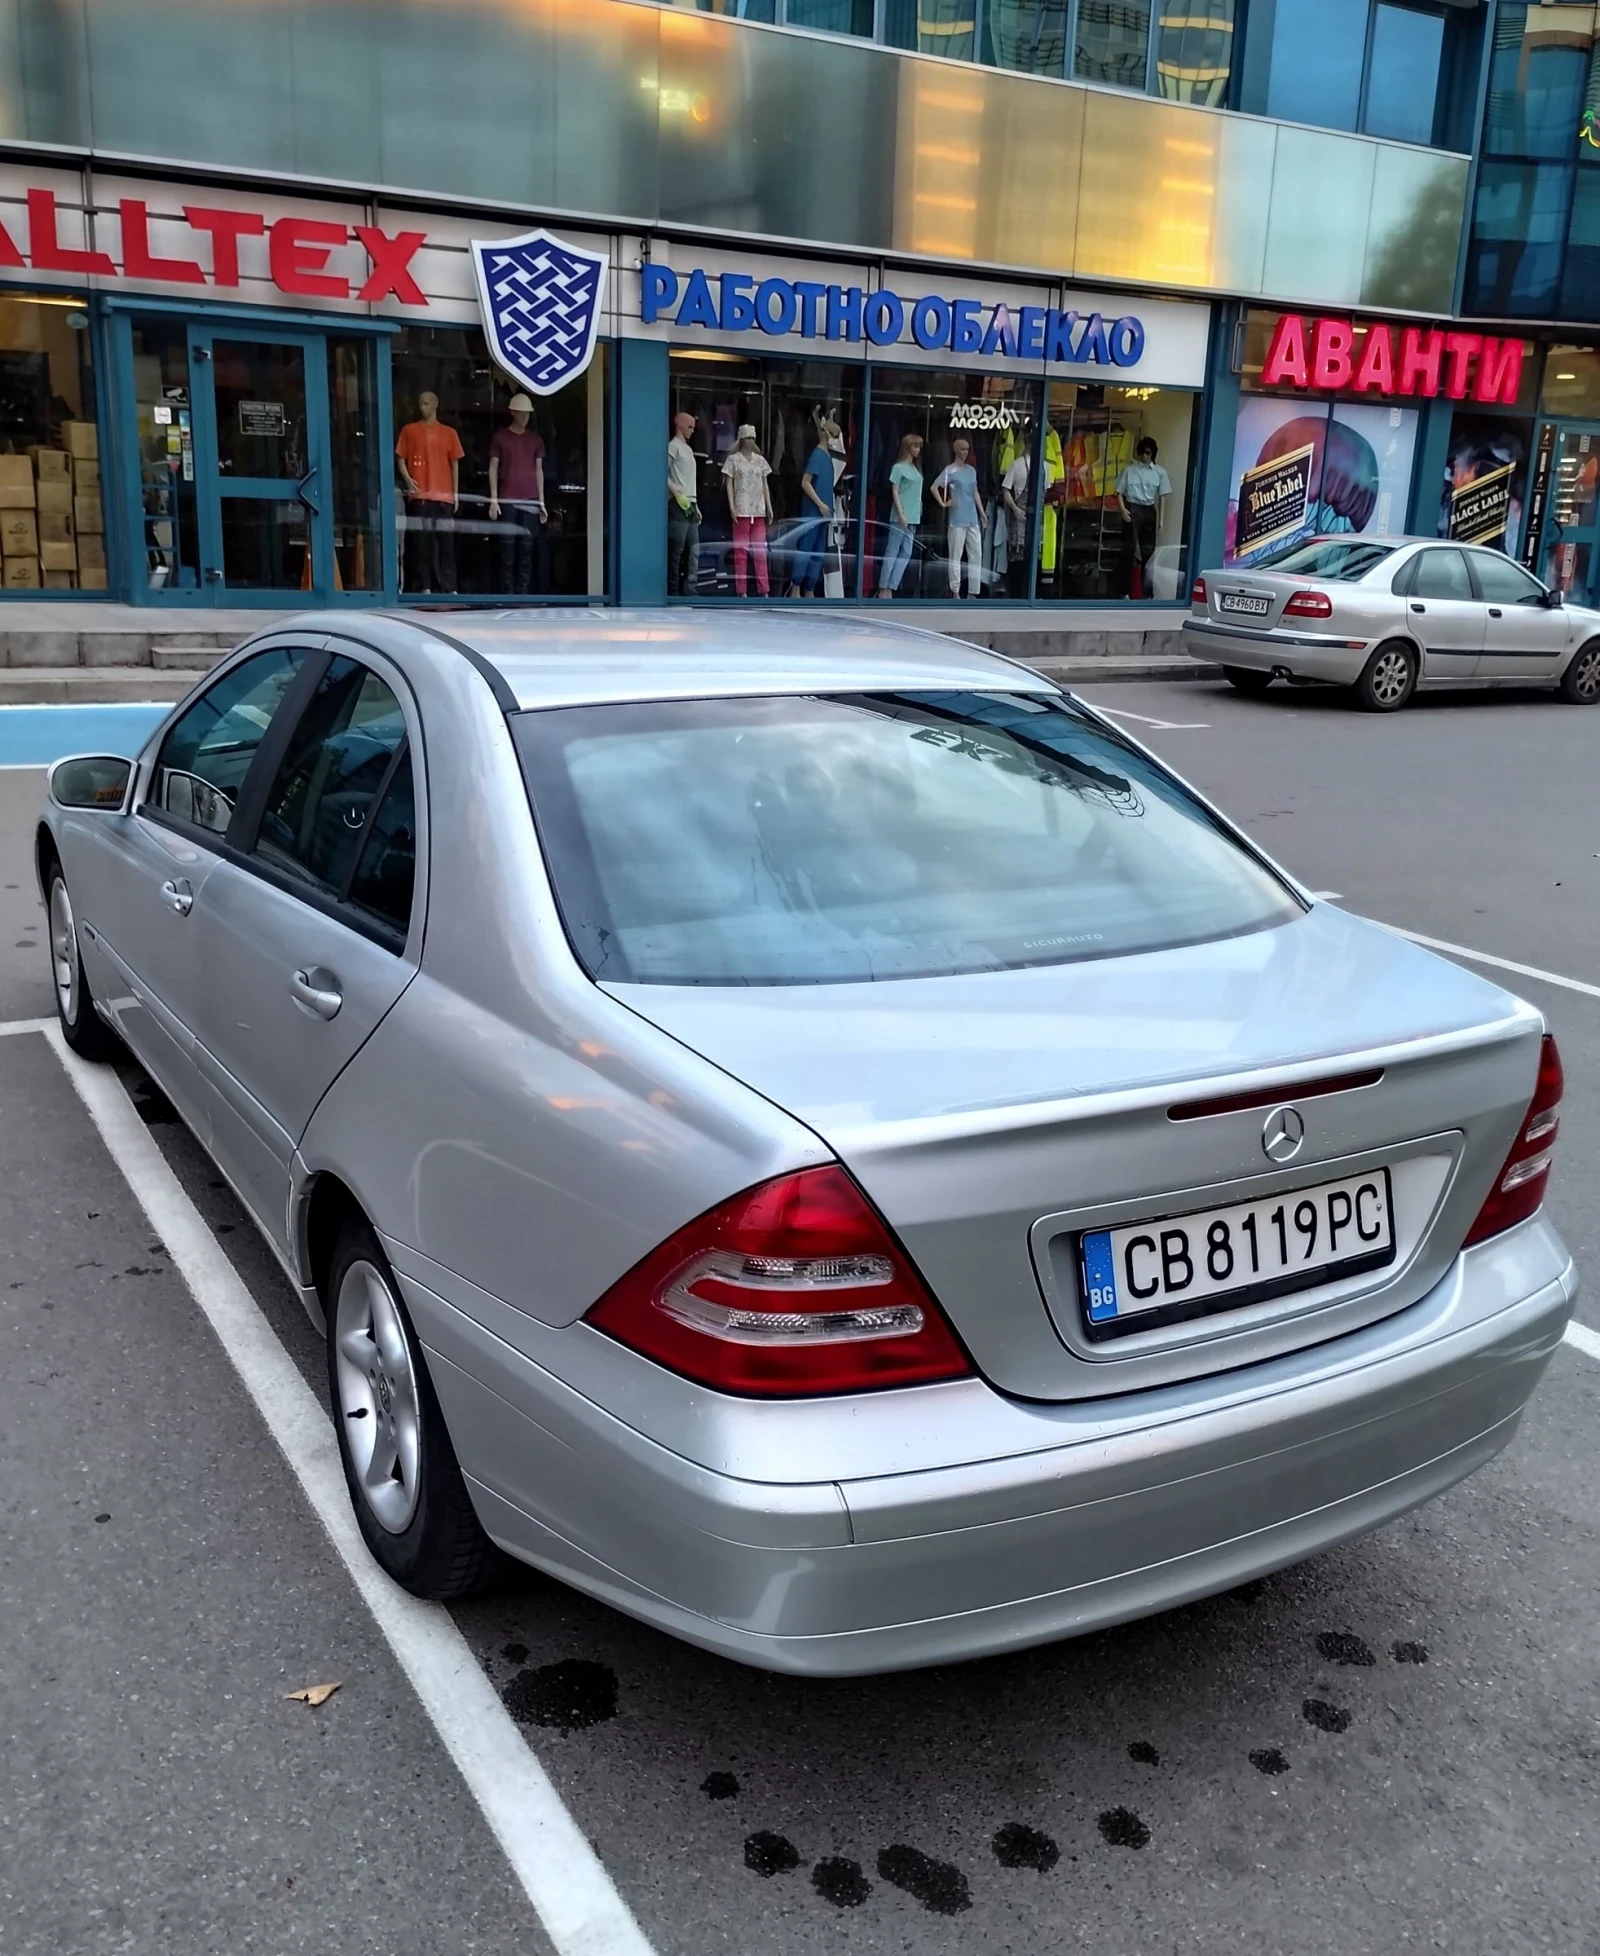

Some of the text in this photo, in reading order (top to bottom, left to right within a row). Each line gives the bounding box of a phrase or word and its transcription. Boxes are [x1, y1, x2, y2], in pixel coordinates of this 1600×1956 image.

[641, 263, 1147, 367] РАБОТНО ОБЛЕКЛО
[1261, 314, 1526, 404] АВАНТИ
[1249, 488, 1276, 513] Blue
[1274, 472, 1304, 501] Label
[1450, 502, 1480, 525] BLACK
[1481, 488, 1510, 510] LABEL
[1023, 933, 1103, 949] SICURAUTO
[1089, 1285, 1114, 1309] BG
